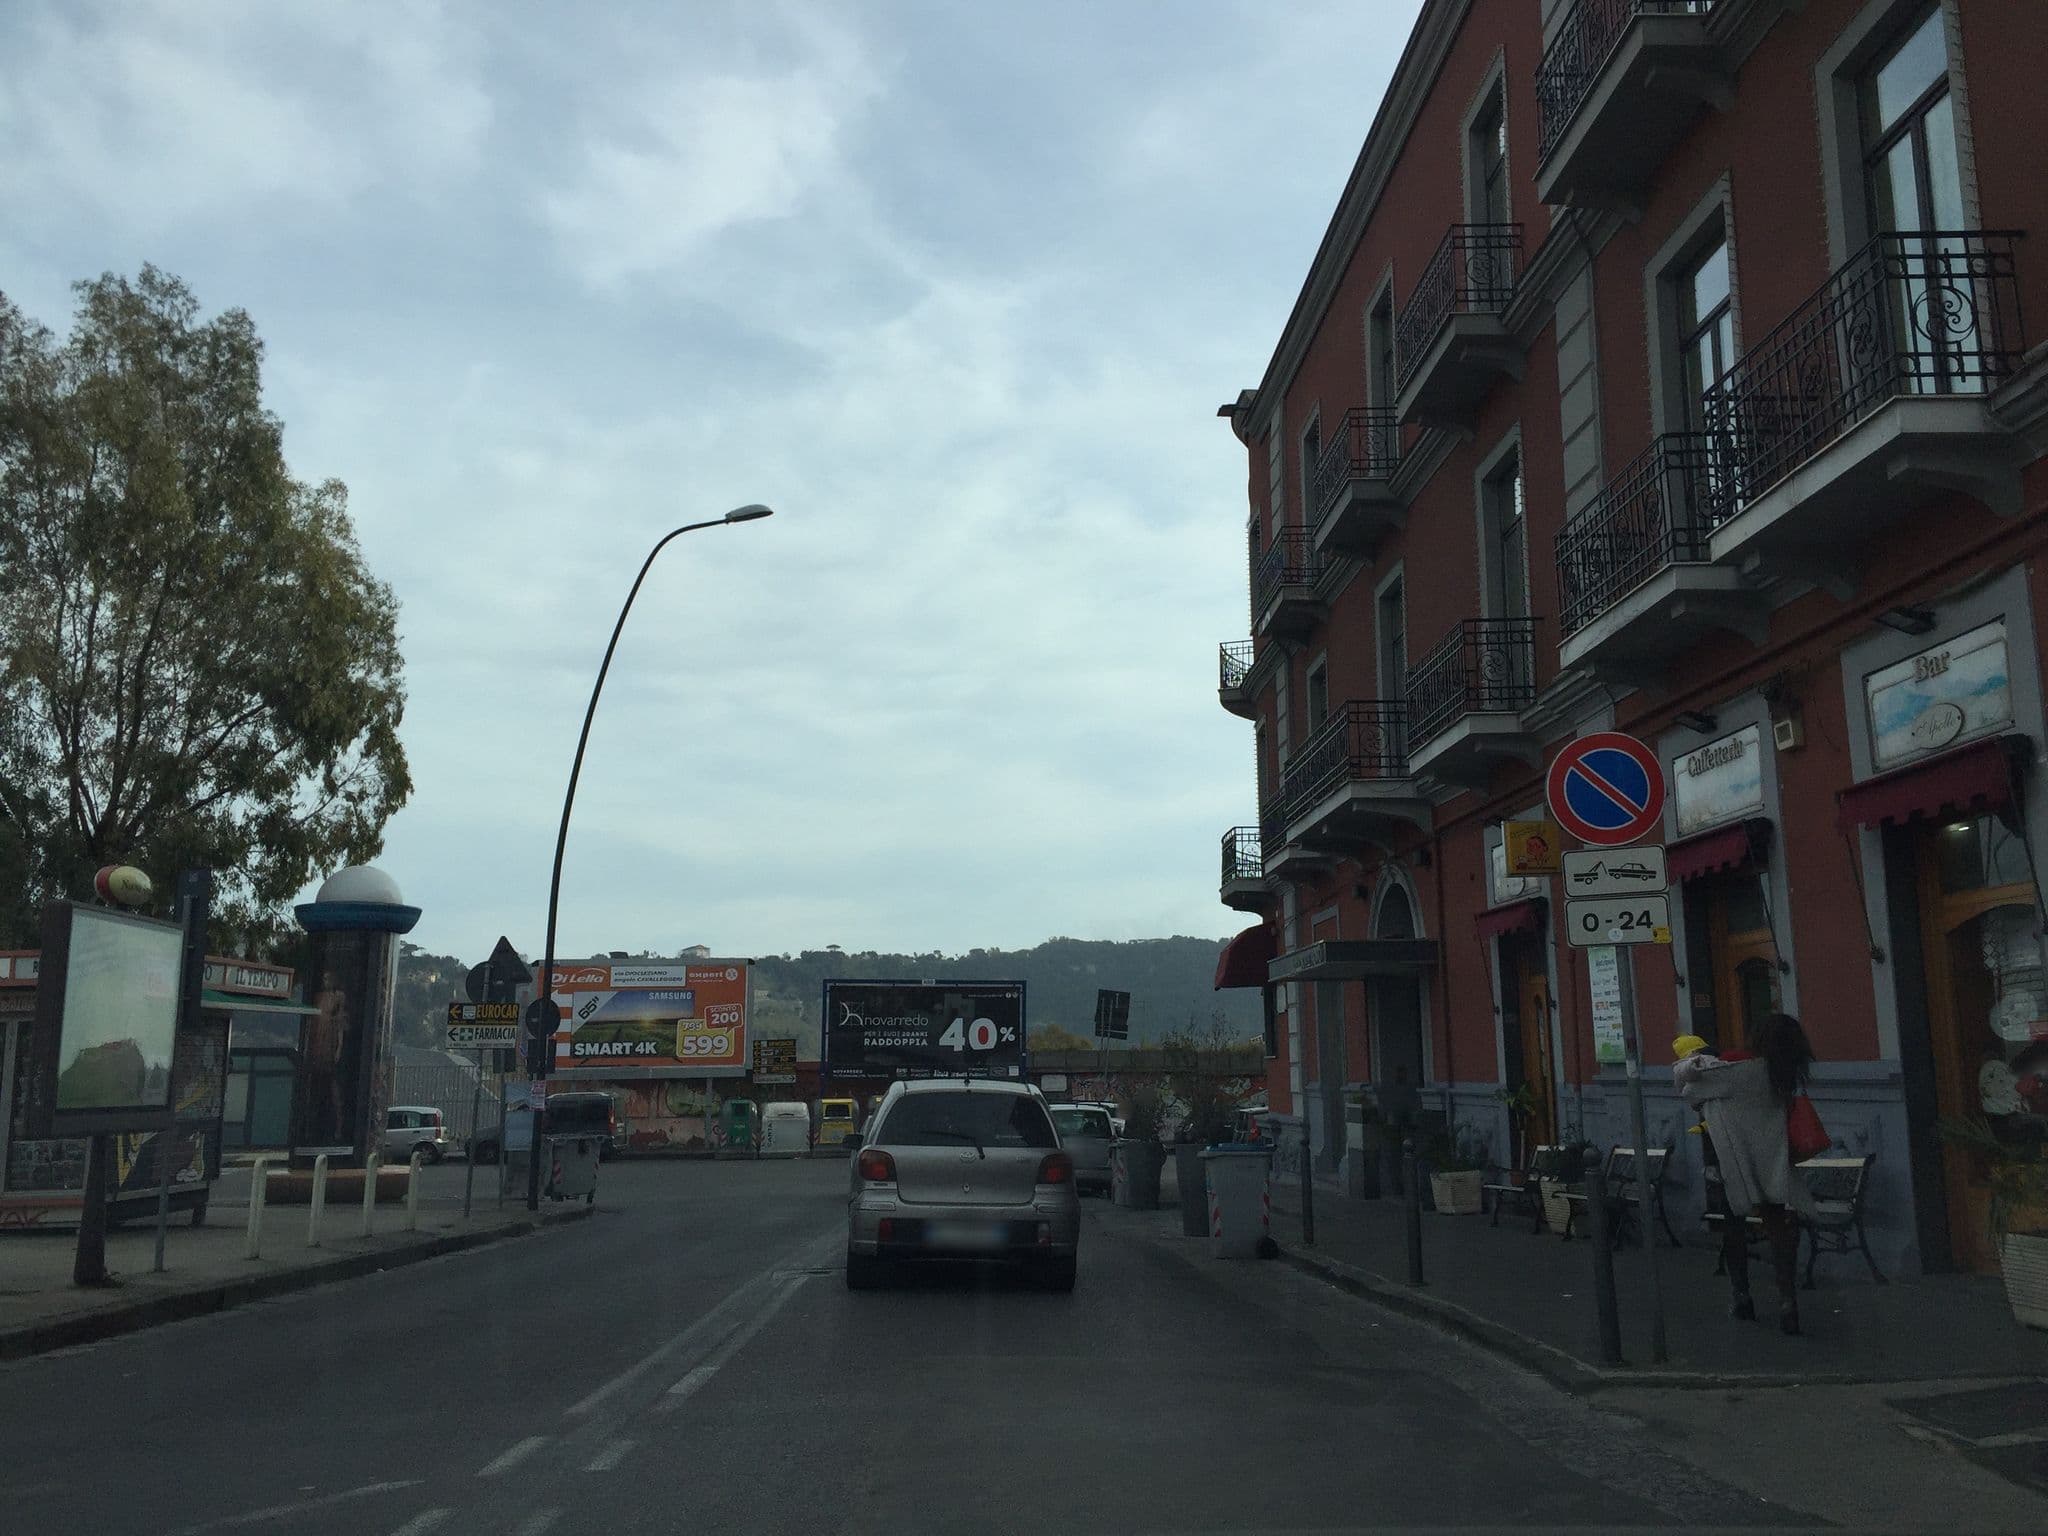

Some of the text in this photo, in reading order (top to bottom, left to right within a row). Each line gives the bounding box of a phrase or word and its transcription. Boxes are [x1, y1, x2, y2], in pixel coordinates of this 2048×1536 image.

[1914, 652, 1950, 683] Bar
[1687, 738, 1744, 777] Caffetteria
[236, 968, 279, 988] IL TEMPO
[569, 973, 604, 984] Lella
[689, 971, 723, 979] expert
[649, 991, 692, 1000] SAMSUNG
[476, 1004, 518, 1018] EUROCAR
[711, 1012, 739, 1025] 200
[864, 1014, 928, 1026] novarredo
[475, 1027, 516, 1040] FARMACIA
[574, 1041, 657, 1056] SMART 4K
[682, 1036, 729, 1055] 599
[864, 1038, 928, 1046] RADDOPPIA
